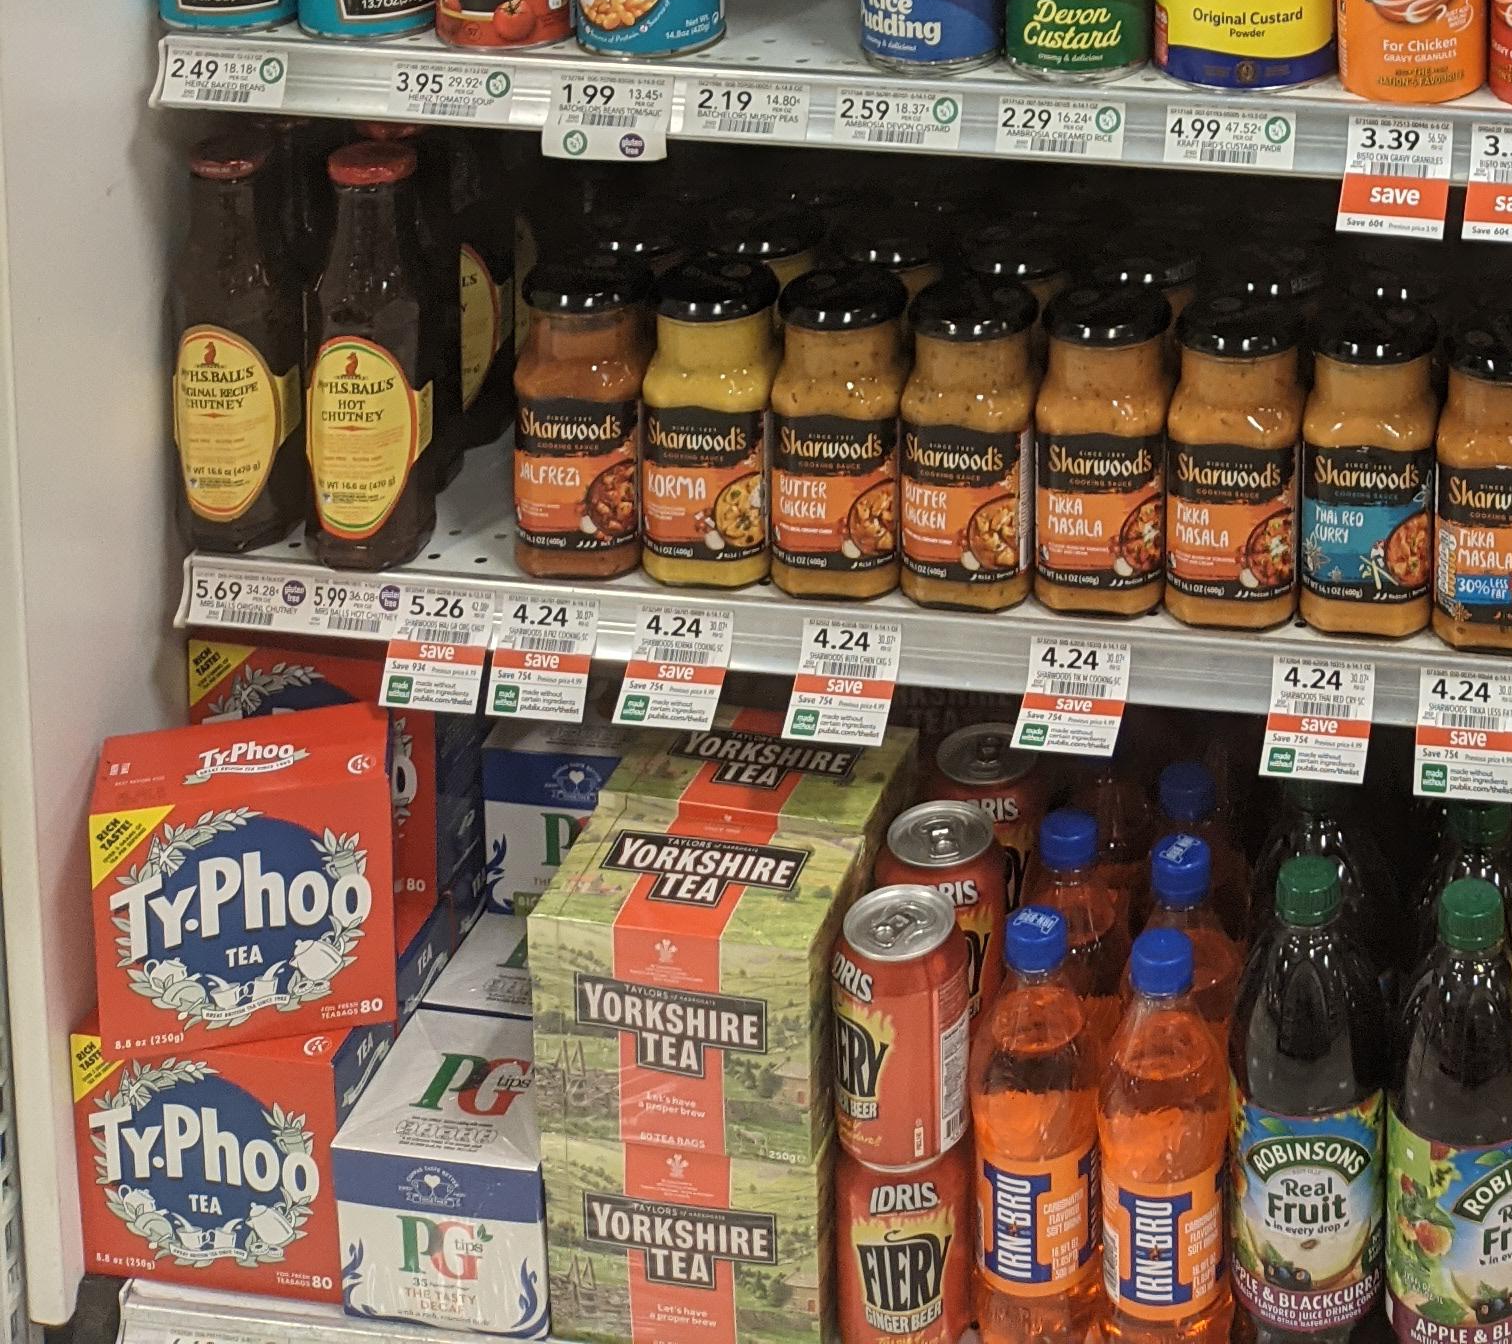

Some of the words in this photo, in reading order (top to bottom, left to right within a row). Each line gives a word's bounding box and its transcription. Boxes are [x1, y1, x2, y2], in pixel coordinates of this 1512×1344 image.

[1033, 0, 1111, 24] Devon
[1192, 9, 1246, 26] Original
[1250, 8, 1303, 23] Custard
[1023, 20, 1121, 49] Custard
[172, 59, 218, 80] 2.49
[1361, 130, 1419, 151] 3.39
[321, 409, 384, 423] CHUTNEY
[337, 399, 365, 411] HOT
[1314, 456, 1419, 489] Sharwood's
[1283, 668, 1343, 690] 4.24
[225, 947, 264, 967] TEA
[581, 982, 759, 1049] YORKSHIRE
[1254, 1142, 1366, 1174] ROBINSONS
[870, 1183, 939, 1211] IDRIS
[1268, 1196, 1346, 1225] Fruit
[865, 1309, 907, 1332] GINGER
[911, 1303, 942, 1330] BEER
